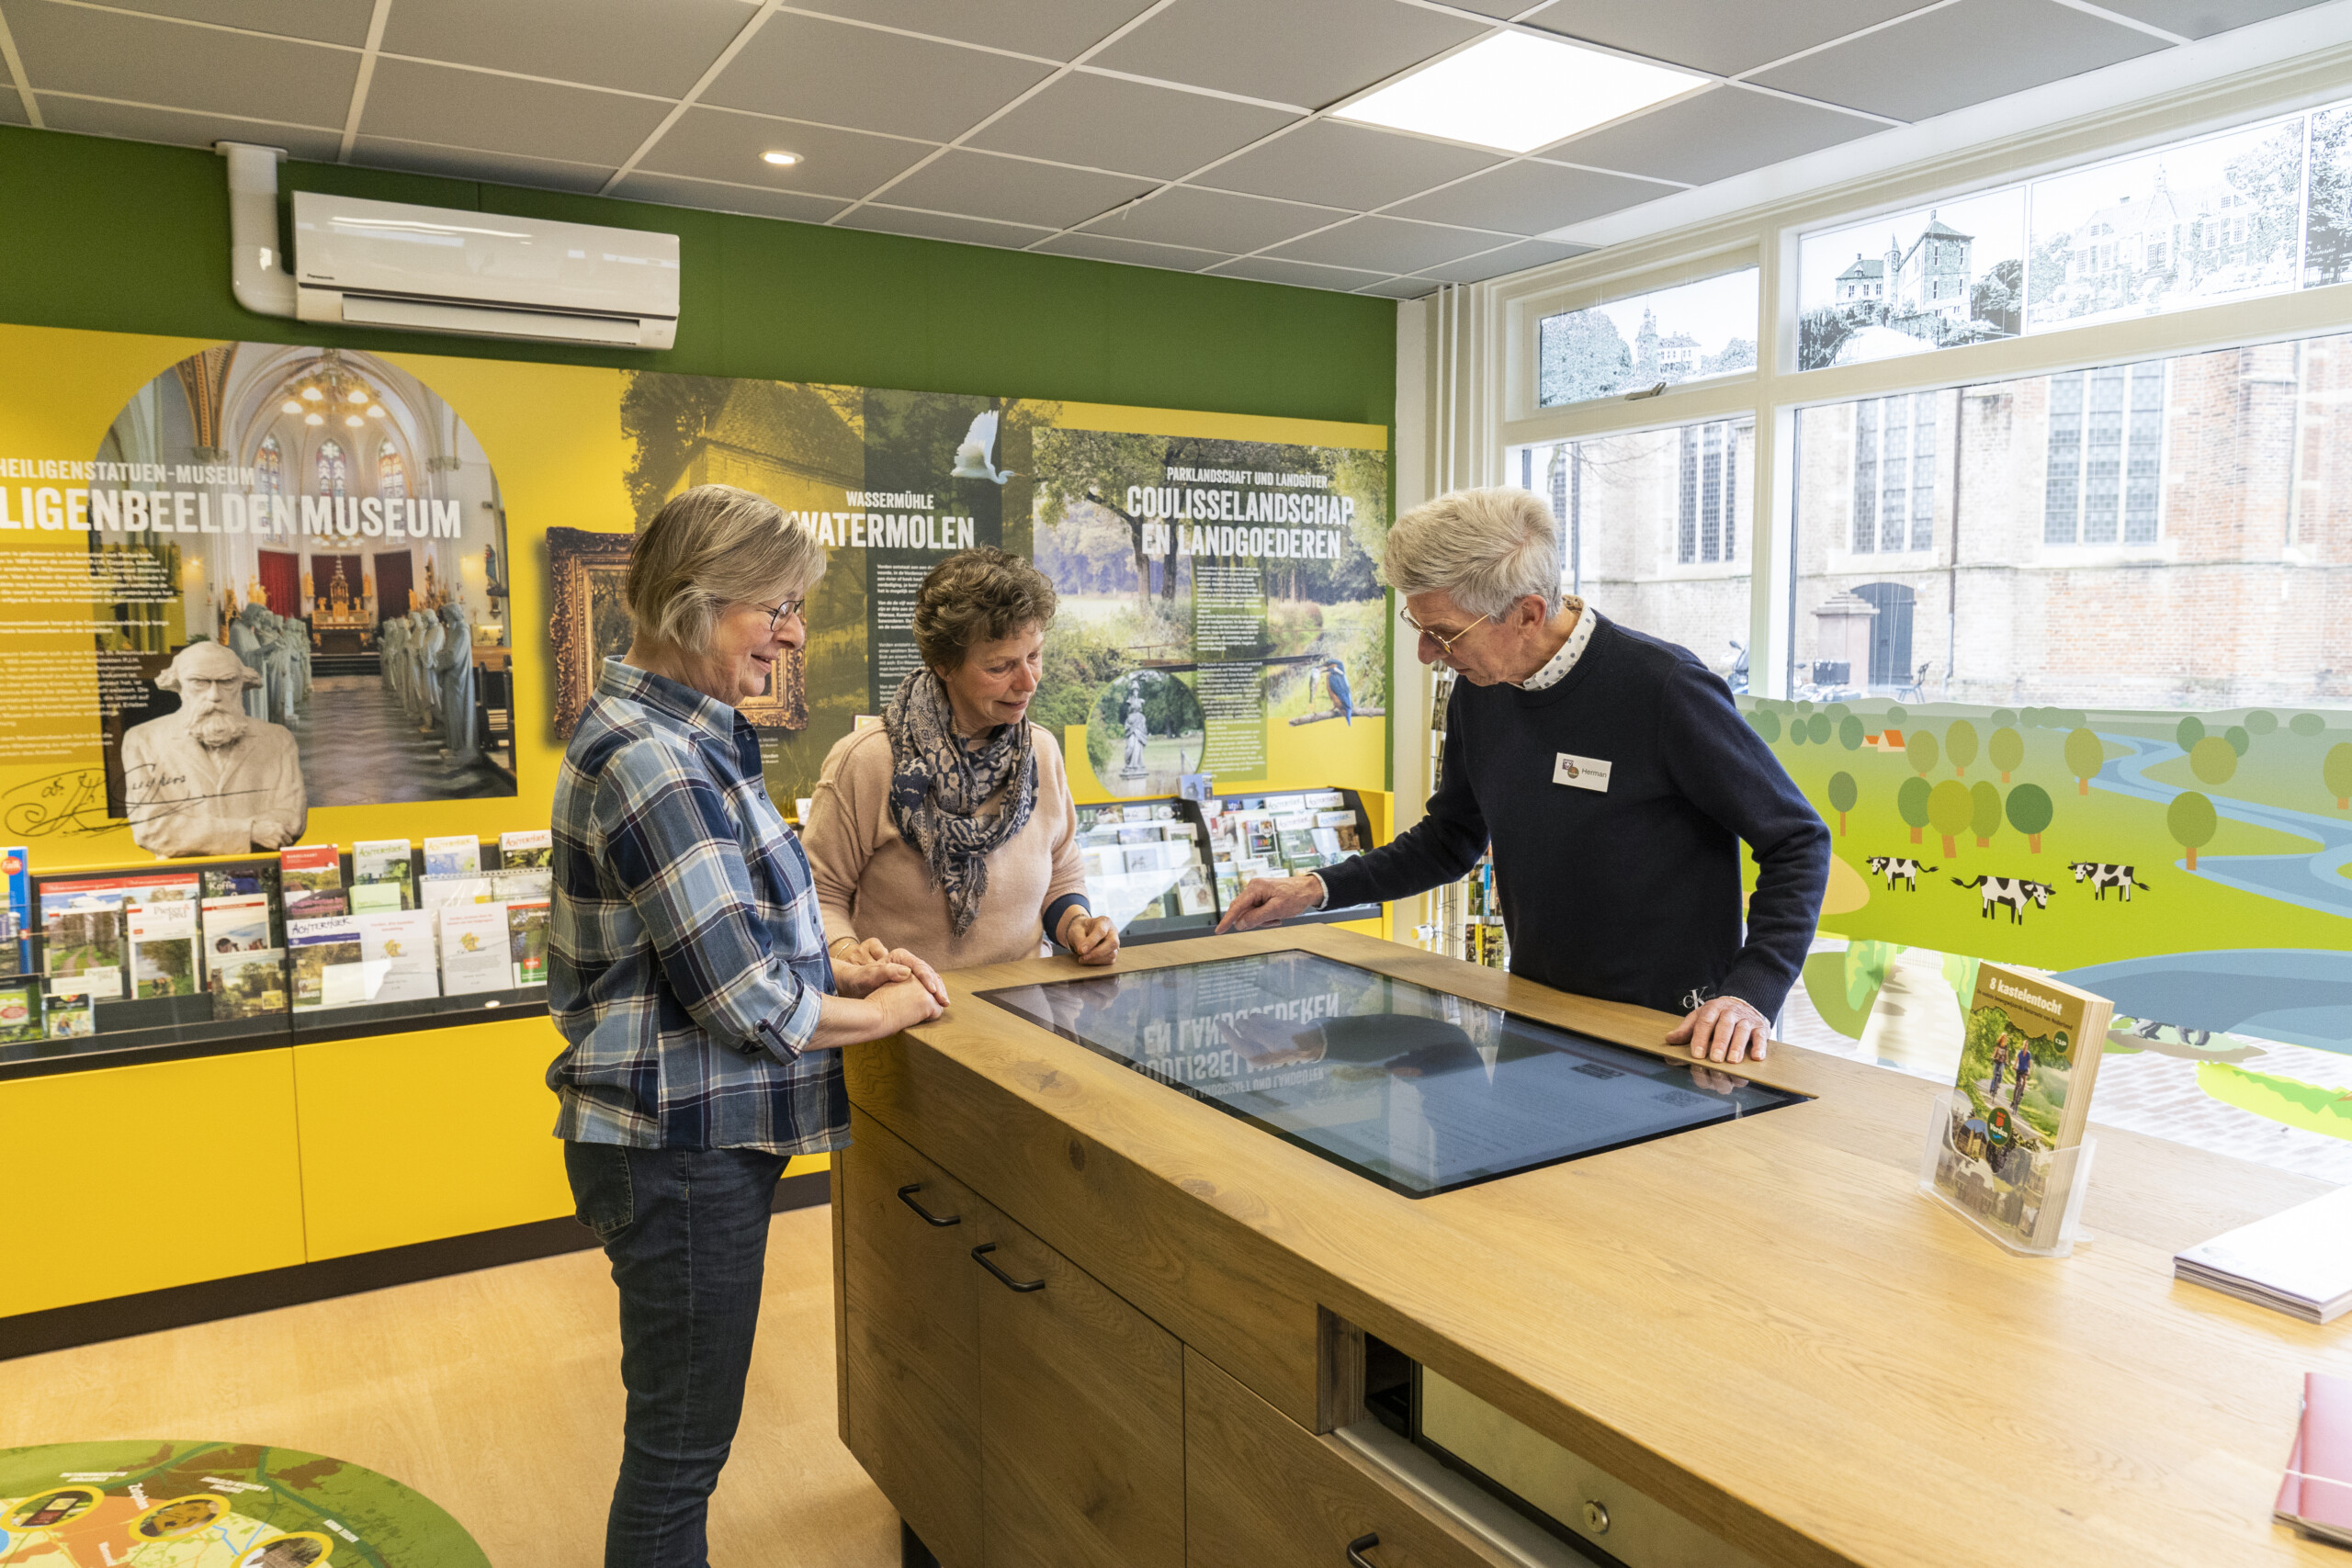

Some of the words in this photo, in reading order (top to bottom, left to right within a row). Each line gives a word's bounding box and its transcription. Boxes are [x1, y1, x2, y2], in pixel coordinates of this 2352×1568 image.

[1167, 467, 1252, 486] PARKLANDSCHAFT
[1254, 472, 1273, 486] UND
[1275, 471, 1328, 489] LANDGÜTER
[846, 491, 934, 510] WASSERMÜHLE
[1126, 485, 1354, 525] COULISSELANDSCHAP
[792, 511, 974, 549] WATERMOLEN
[1142, 523, 1170, 555] EN
[1178, 525, 1341, 559] LANDGOEDEREN
[1582, 768, 1607, 778] Herman
[209, 880, 237, 891] Koffie
[1989, 977, 1996, 990] 8
[1997, 979, 2063, 1016] kastelentocht
[1990, 1123, 2008, 1138] Vorden
